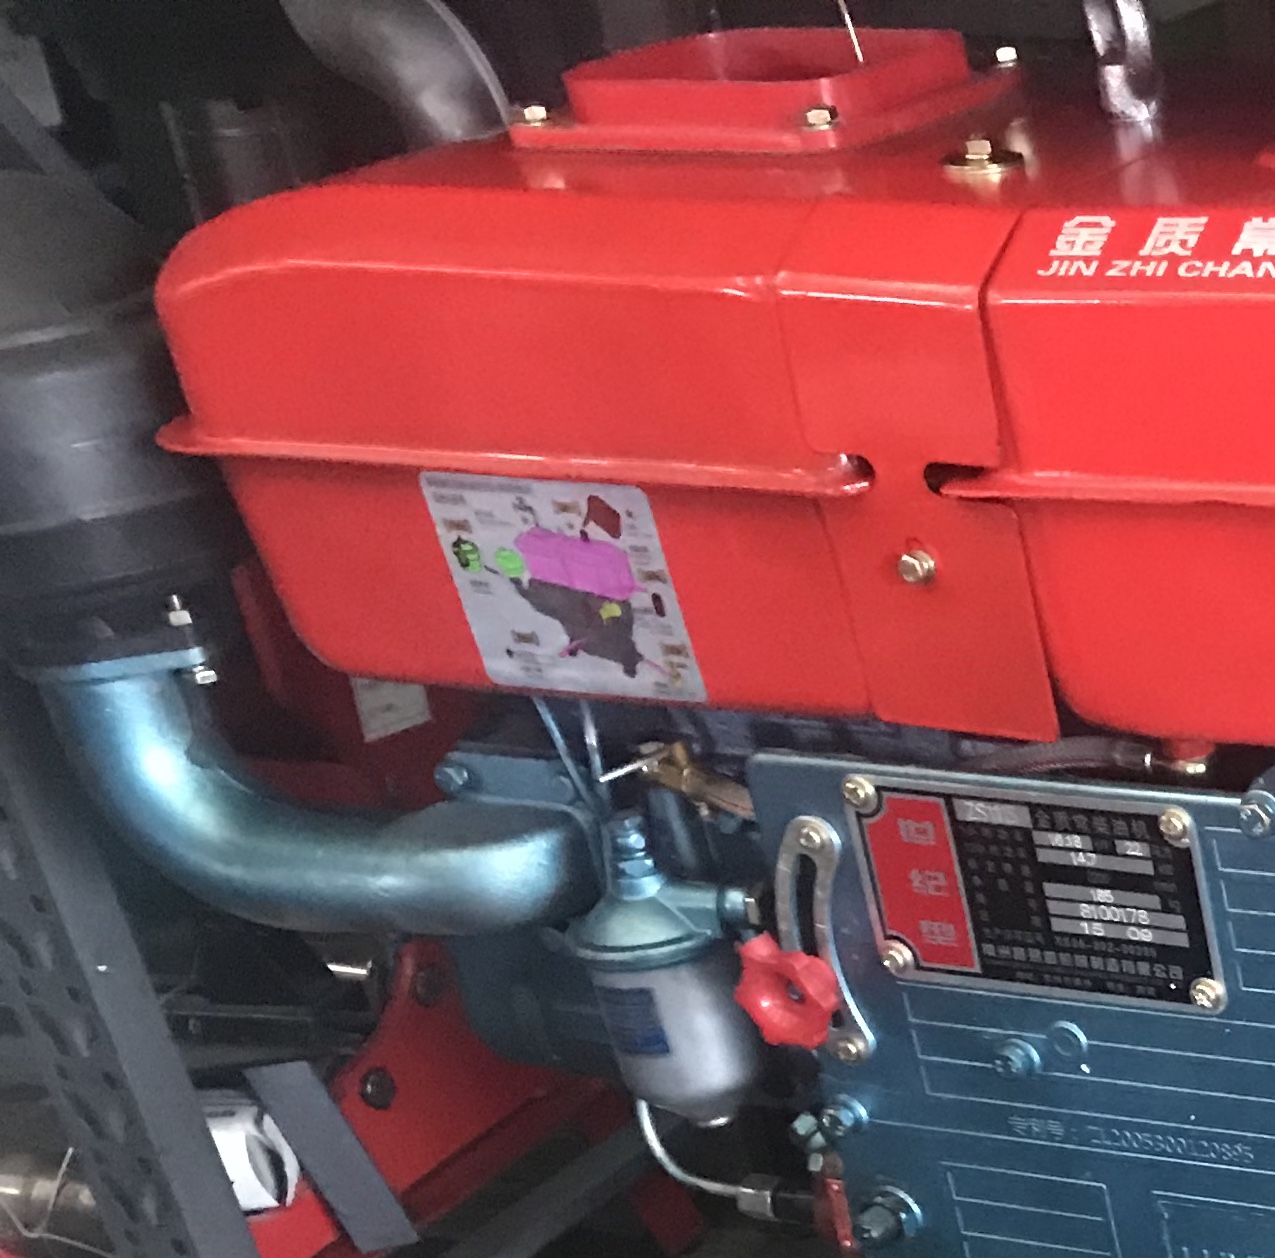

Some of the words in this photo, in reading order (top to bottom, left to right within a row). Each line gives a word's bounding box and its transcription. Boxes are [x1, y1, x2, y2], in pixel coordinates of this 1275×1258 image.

[1037, 259, 1100, 277] JIN
[1105, 259, 1169, 278] ZHI
[1079, 903, 1151, 925] 8100178
[1079, 921, 1105, 937] 15
[1126, 926, 1154, 942] 09
